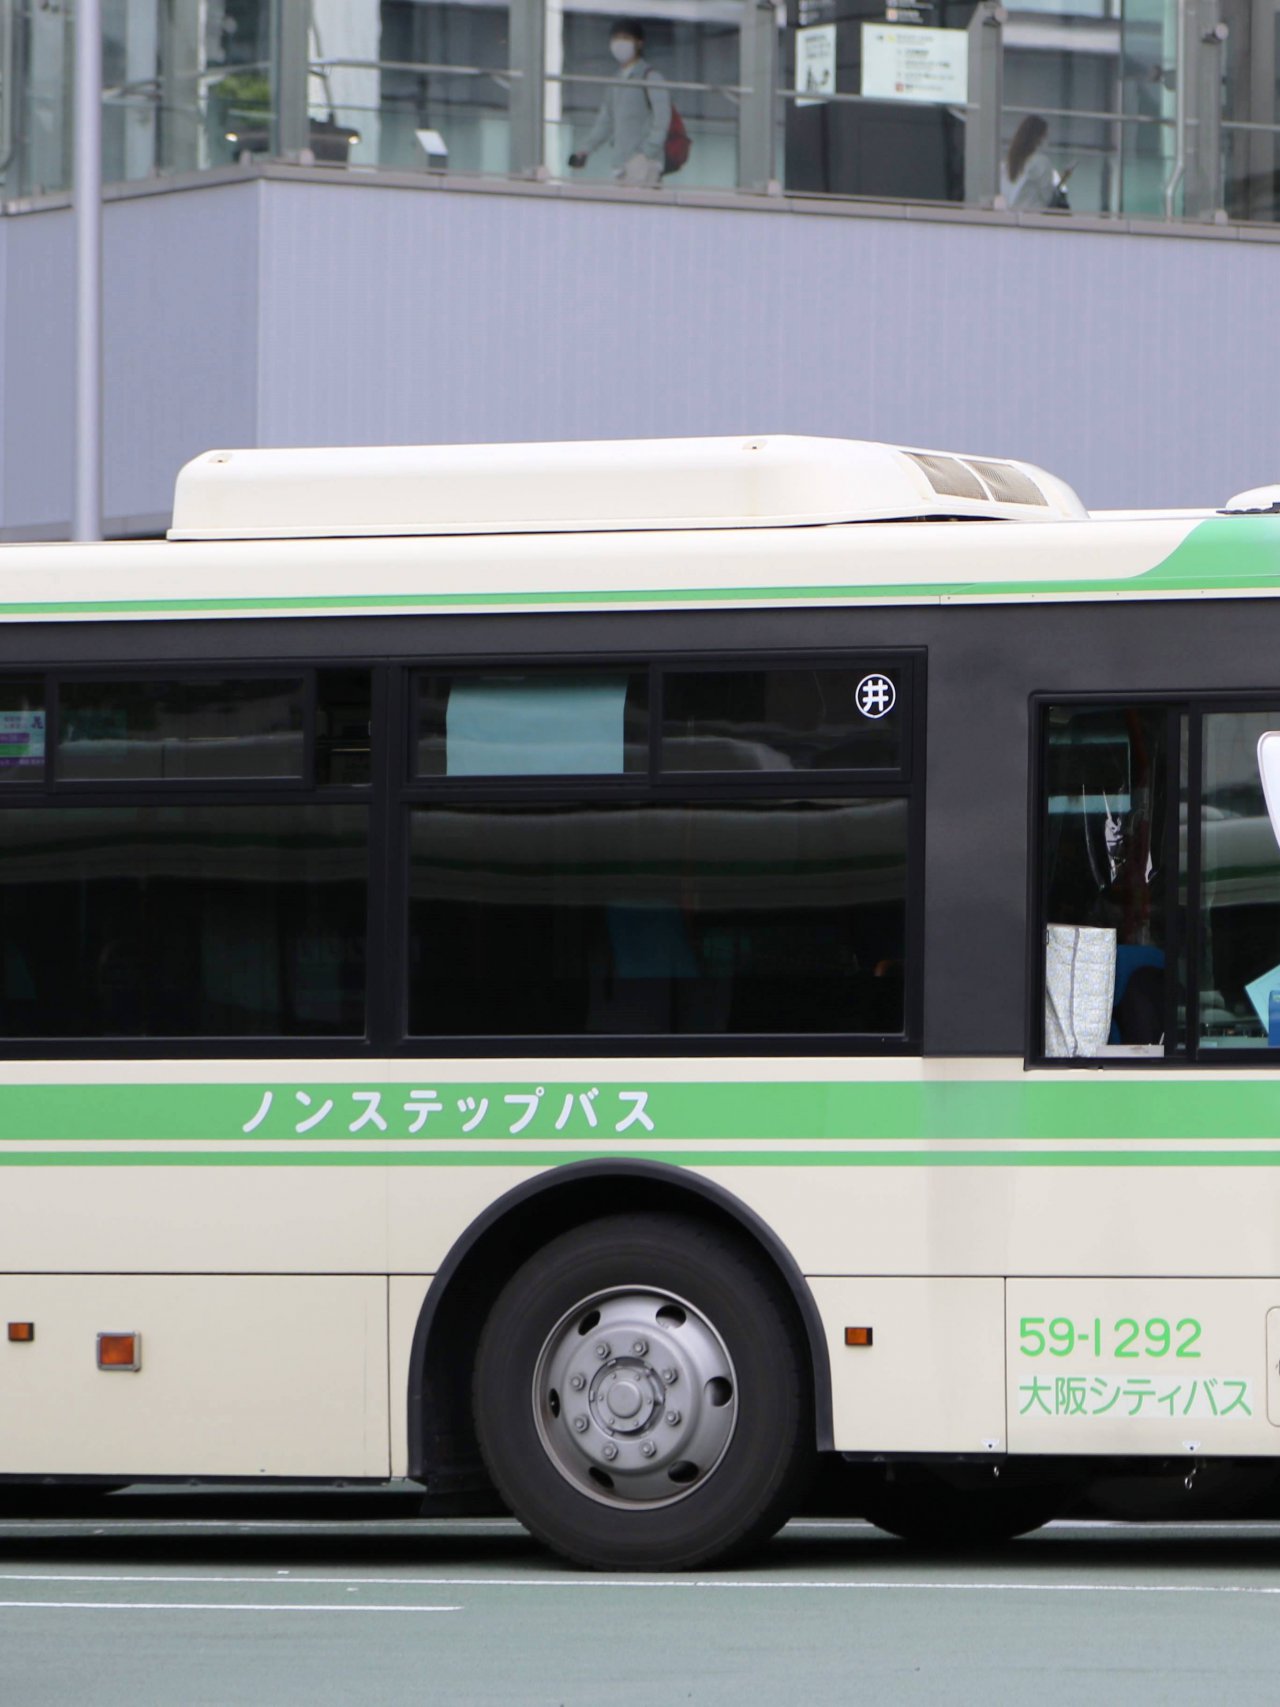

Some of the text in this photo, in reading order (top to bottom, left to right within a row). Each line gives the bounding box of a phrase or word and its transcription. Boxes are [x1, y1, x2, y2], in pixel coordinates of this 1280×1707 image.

[860, 676, 891, 714] 井
[242, 1085, 655, 1134] ノンステップバス
[1019, 1317, 1202, 1358] 59-1292
[1019, 1375, 1252, 1417] 大阪シティバス
